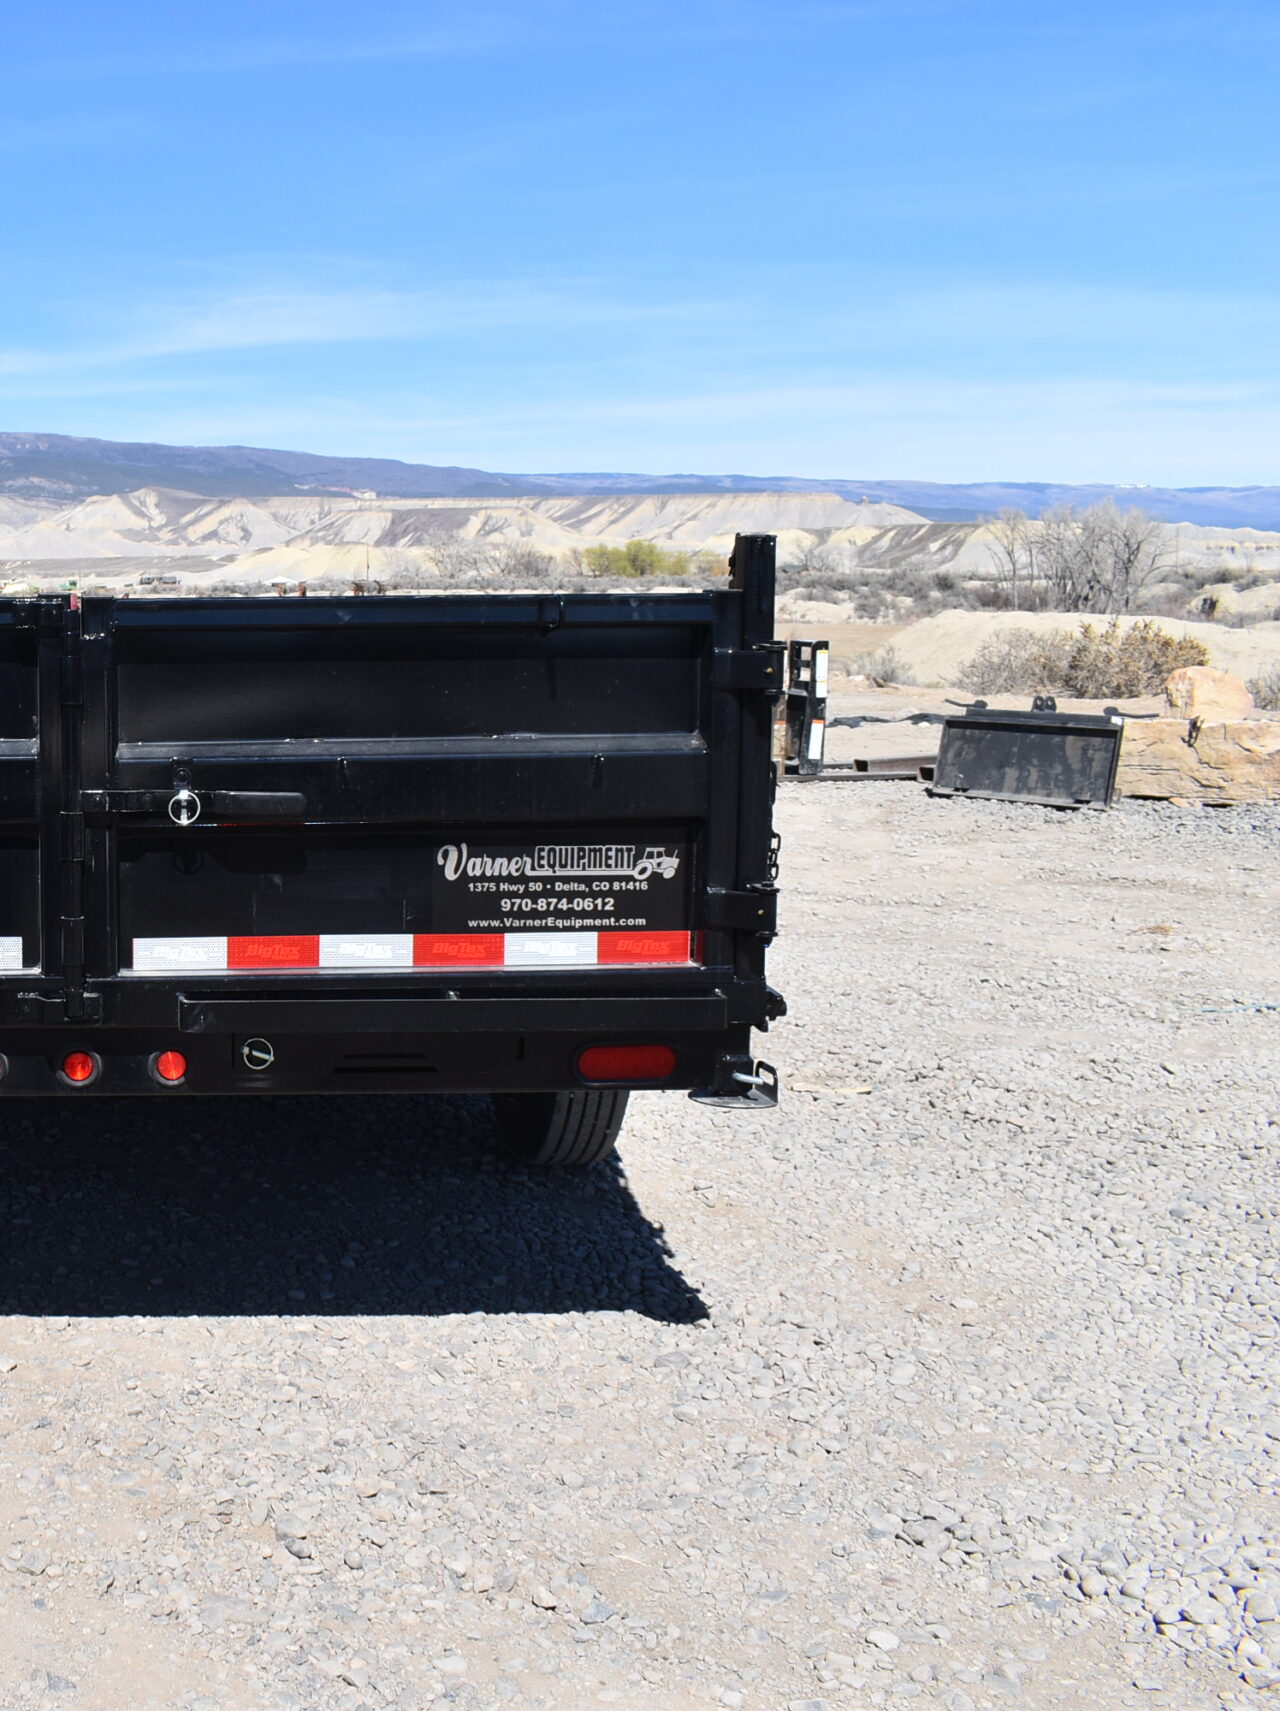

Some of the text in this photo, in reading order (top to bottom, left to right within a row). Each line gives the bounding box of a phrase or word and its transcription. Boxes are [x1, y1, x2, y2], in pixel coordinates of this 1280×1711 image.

[436, 842, 636, 881] Varner EQUIPMENT
[467, 881, 649, 893] 1375 Hwy 50 Delta, CO 81416
[500, 897, 615, 912] 970-874-0612
[467, 916, 647, 929] www.VarnerEquipment.com
